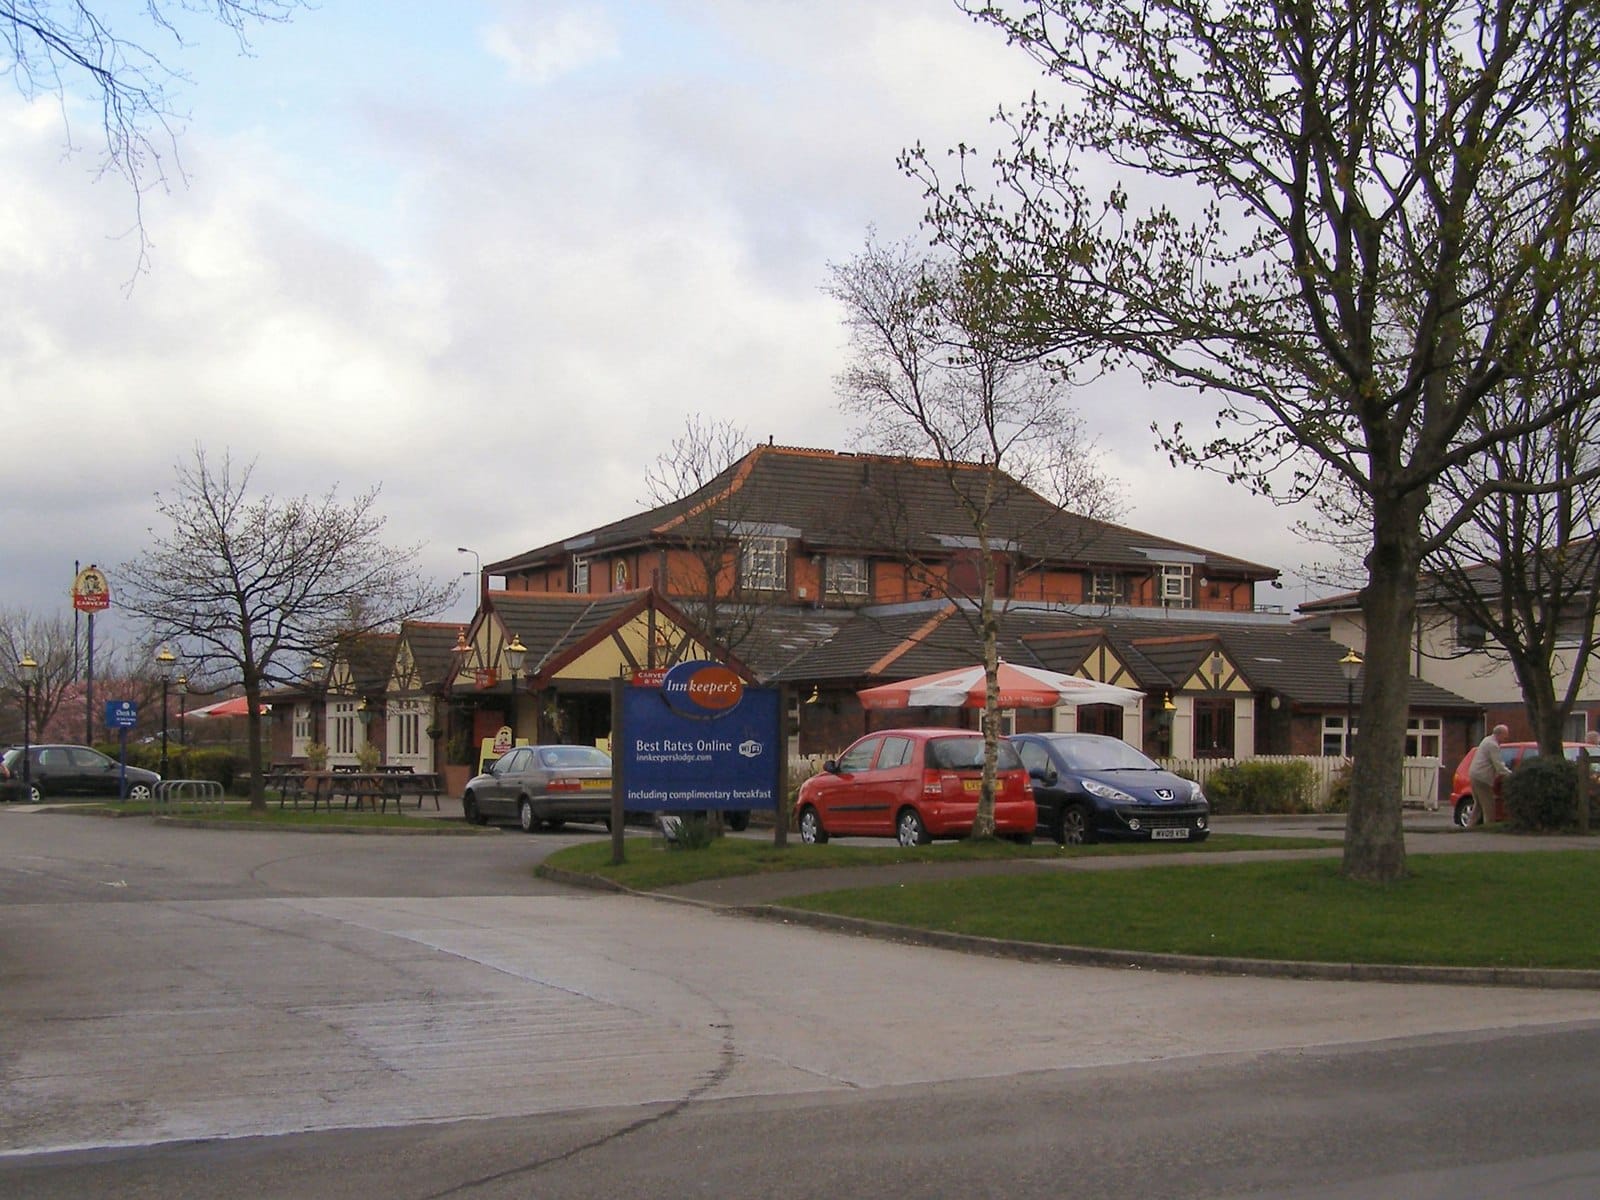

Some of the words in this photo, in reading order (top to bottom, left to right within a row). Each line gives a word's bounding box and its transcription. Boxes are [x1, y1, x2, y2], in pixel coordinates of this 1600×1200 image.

[667, 679, 737, 694] Innkeeper's
[636, 740, 660, 752] Best
[663, 740, 694, 752] Rates
[696, 740, 732, 752] Online
[636, 753, 713, 763] innkeeperslodge.com
[627, 790, 668, 801] including
[669, 790, 731, 801] complimentary
[733, 789, 772, 799] breakfast
